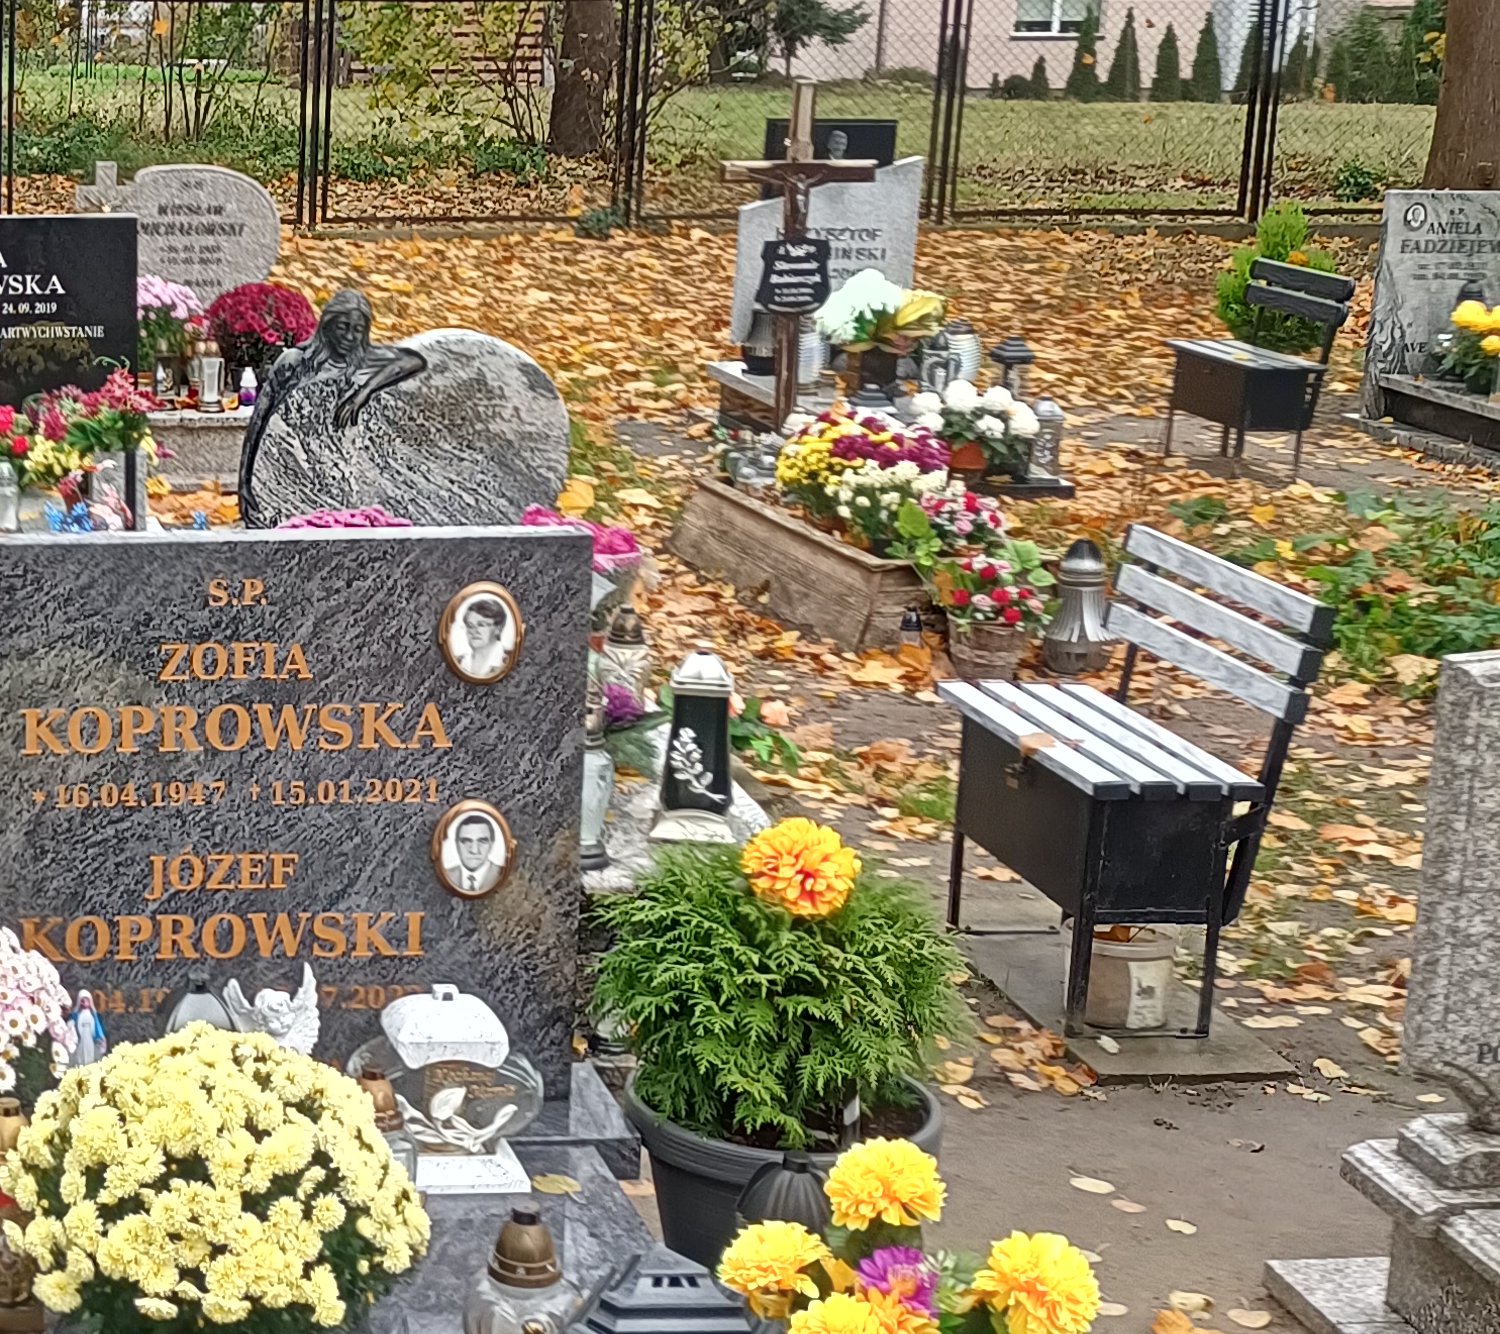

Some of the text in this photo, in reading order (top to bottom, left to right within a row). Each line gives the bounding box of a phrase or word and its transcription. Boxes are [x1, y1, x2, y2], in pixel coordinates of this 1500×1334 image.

[1426, 221, 1483, 236] ANIELA
[157, 641, 314, 682] ZOFIA
[20, 701, 454, 757] KOPROWSKA
[55, 777, 440, 809] 16.04.1947 15.01.2021
[144, 846, 300, 902] JÓZEF
[20, 910, 427, 963] KOPROWSKI
